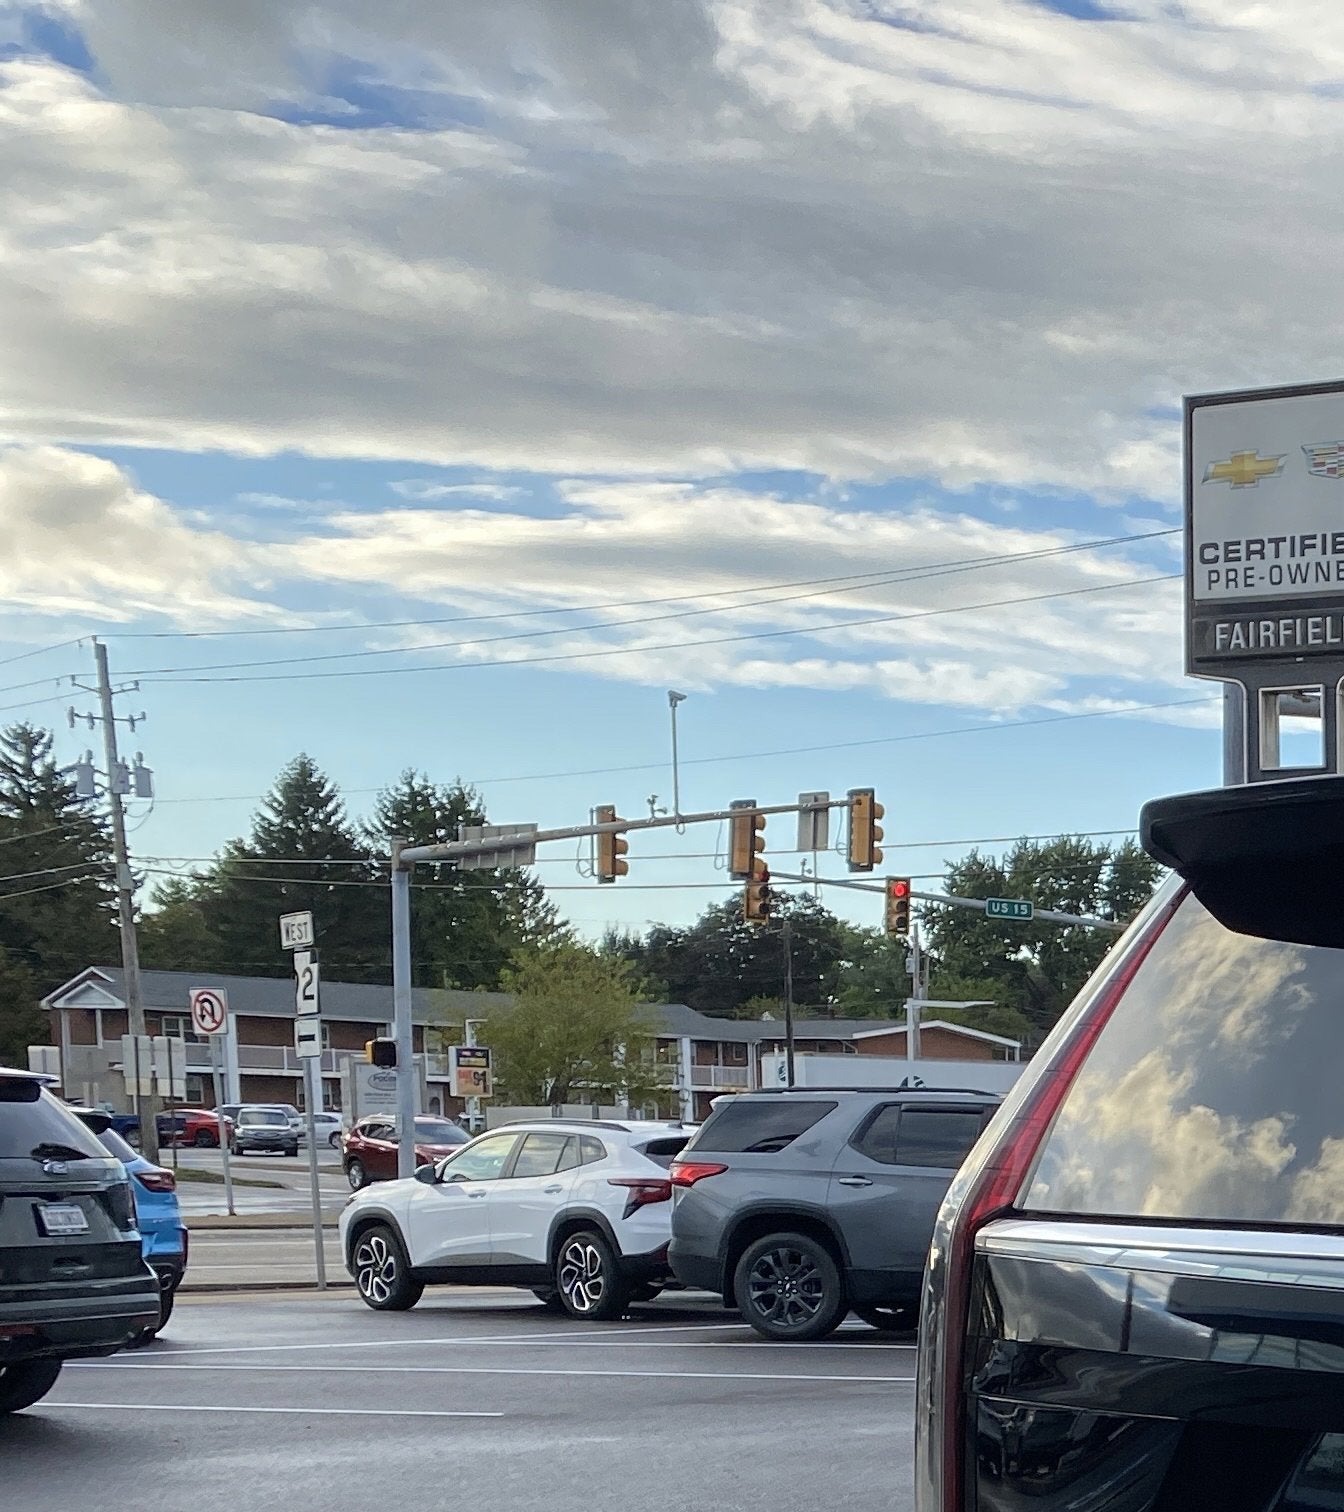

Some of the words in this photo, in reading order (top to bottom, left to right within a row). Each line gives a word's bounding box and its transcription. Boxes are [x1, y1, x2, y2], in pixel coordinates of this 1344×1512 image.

[992, 902, 1009, 913] US
[1014, 904, 1028, 915] 15
[284, 921, 308, 942] WEST
